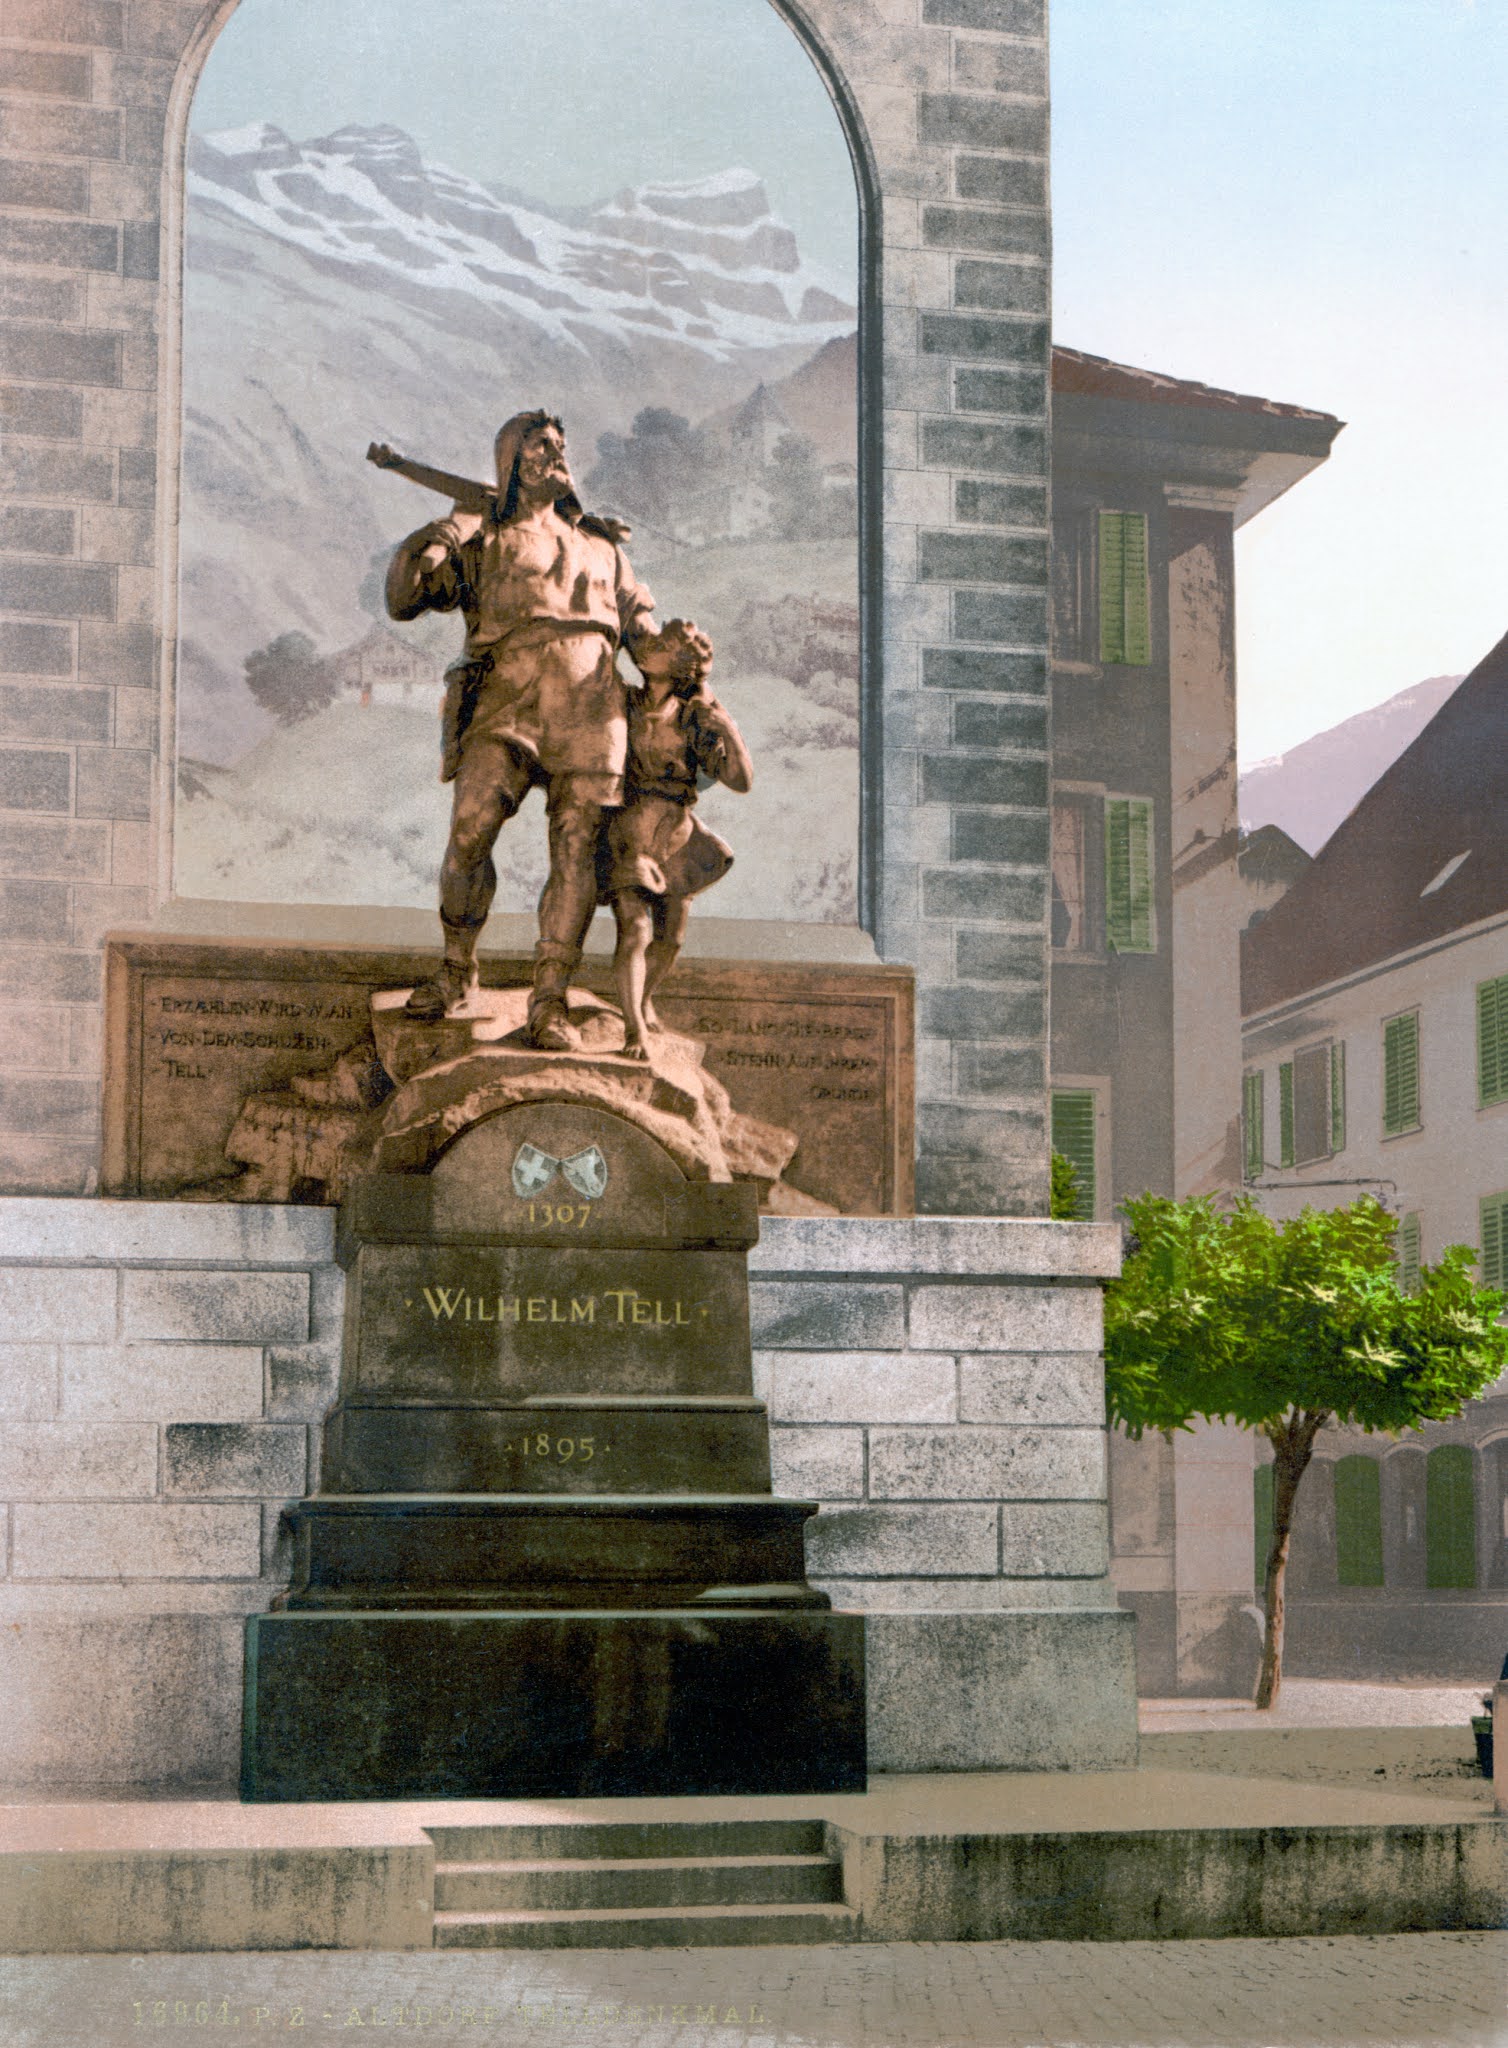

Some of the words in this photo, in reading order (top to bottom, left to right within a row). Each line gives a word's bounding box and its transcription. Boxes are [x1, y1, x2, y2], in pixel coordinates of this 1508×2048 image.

[160, 1028, 195, 1047] VON
[161, 1059, 206, 1079] TELL
[528, 1203, 592, 1229] 1307
[422, 1287, 595, 1324] WILHELM
[604, 1289, 690, 1325] TELL
[523, 1433, 595, 1464] 1895
